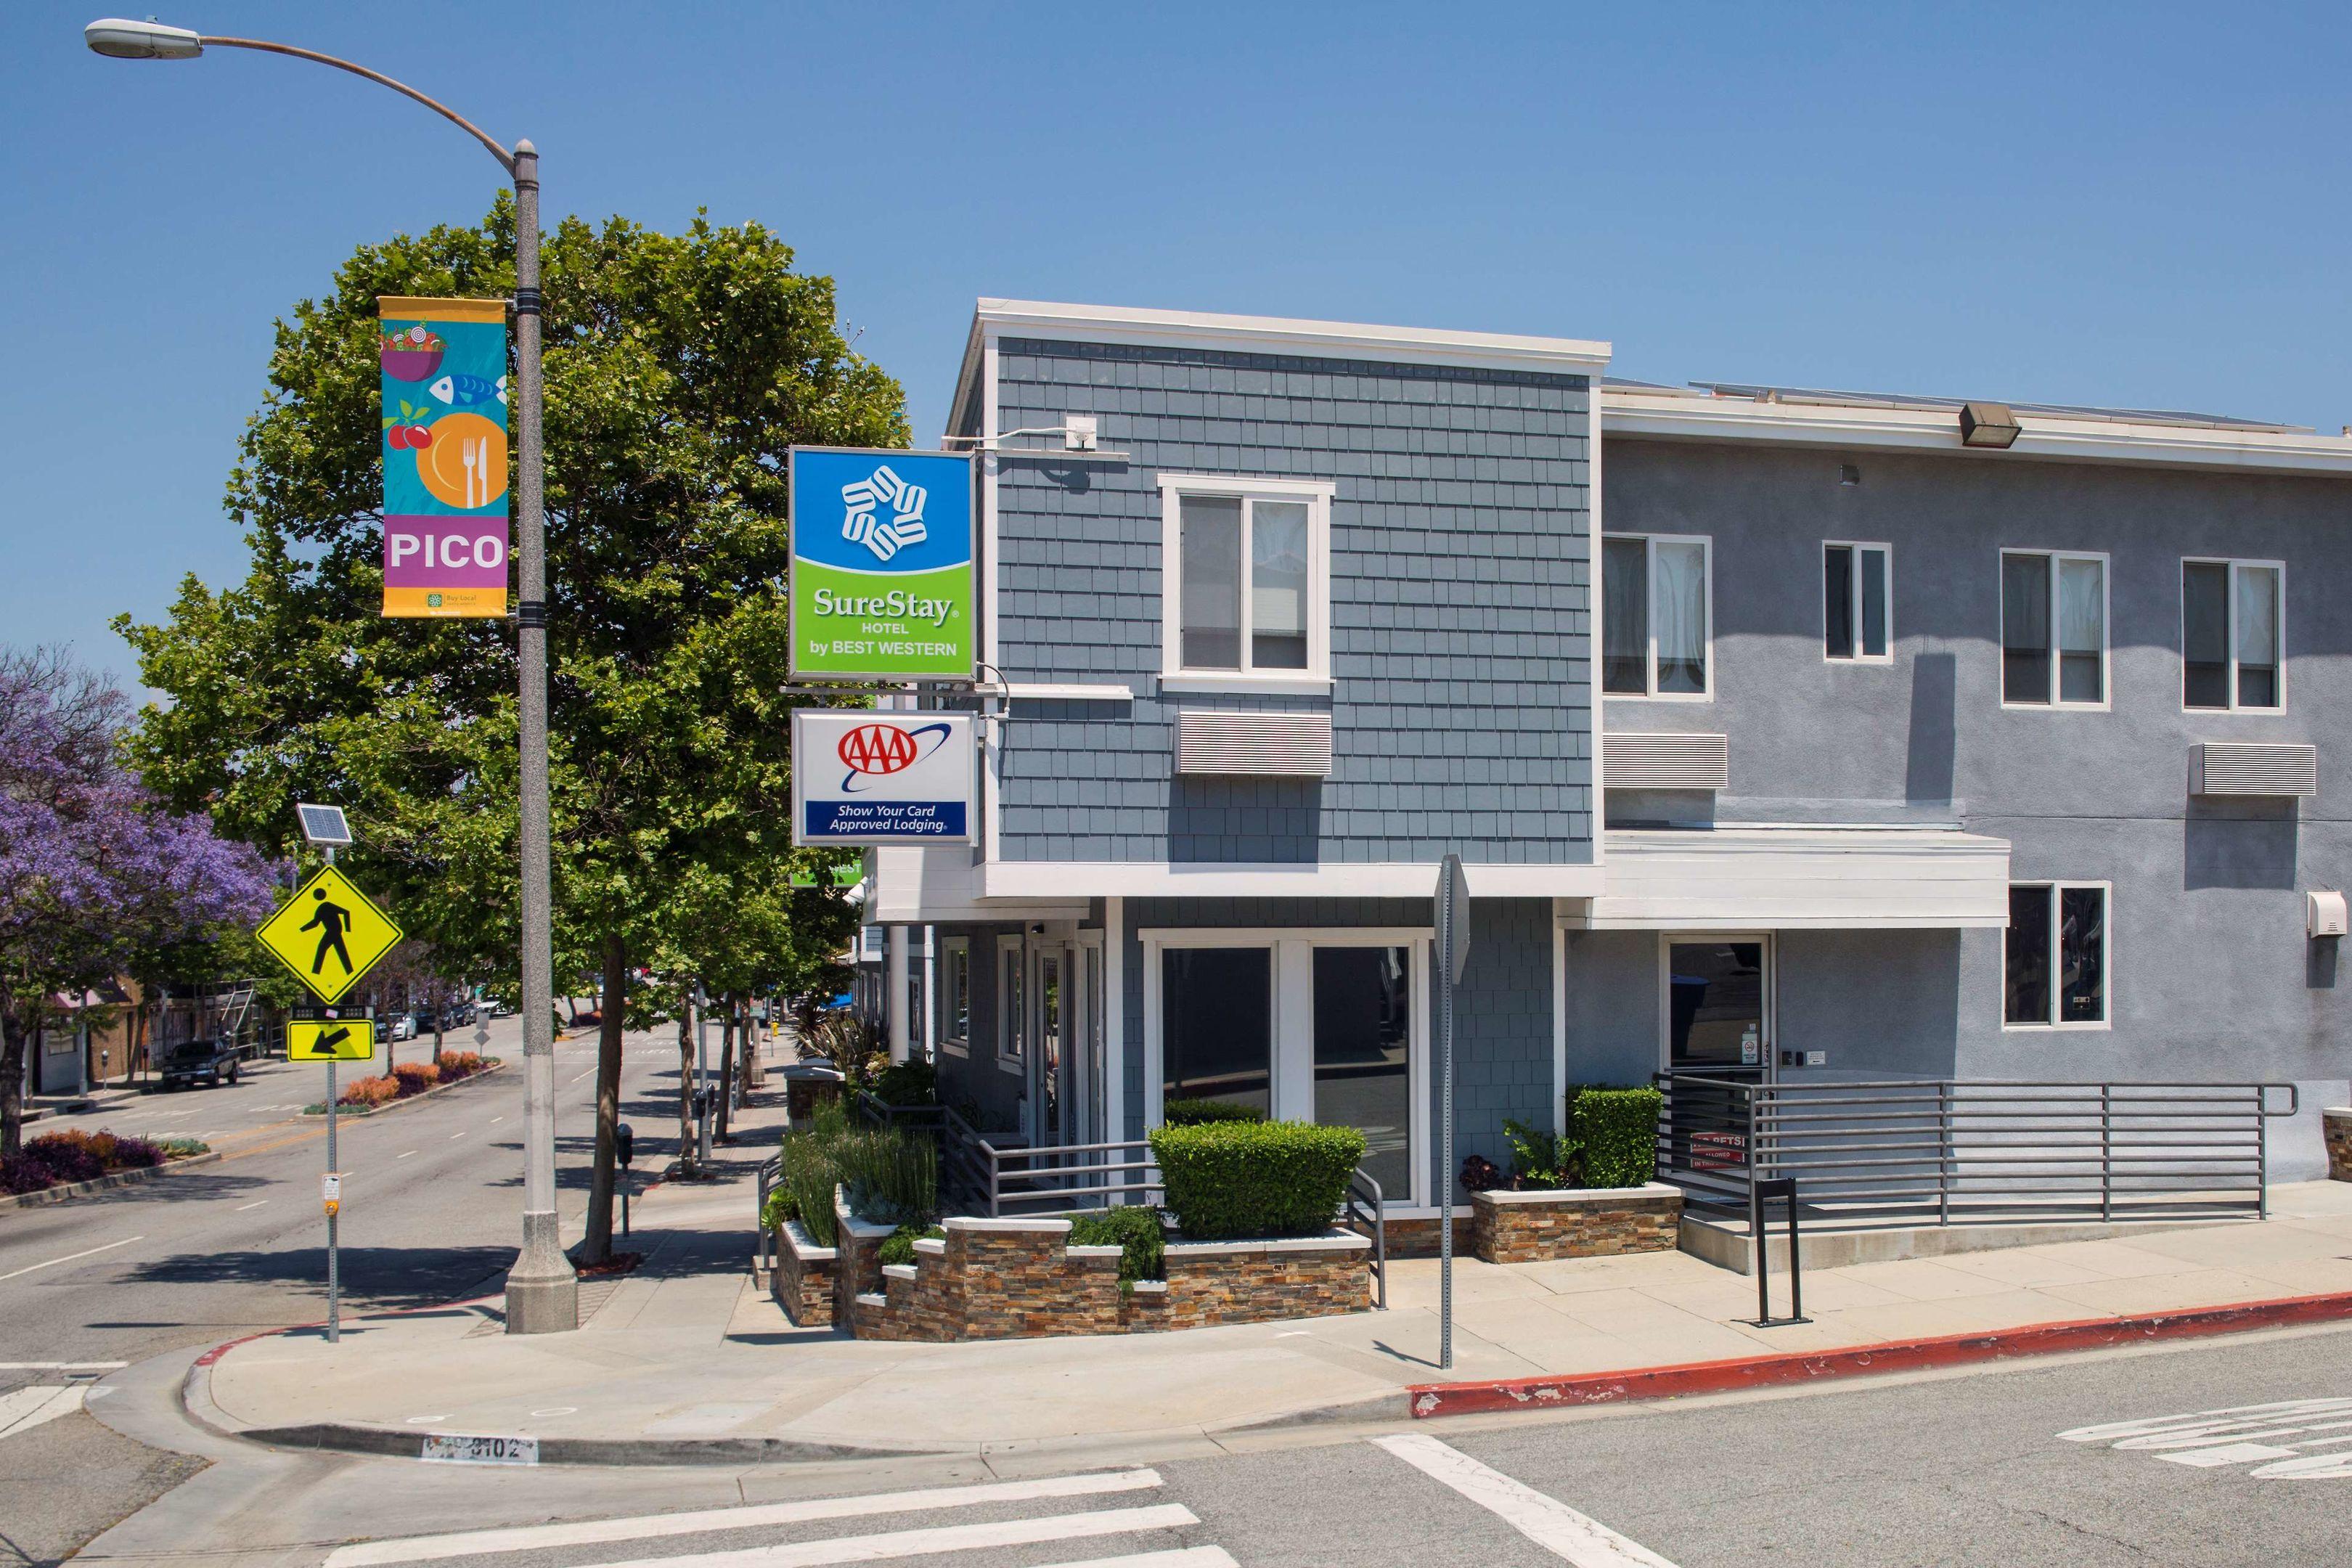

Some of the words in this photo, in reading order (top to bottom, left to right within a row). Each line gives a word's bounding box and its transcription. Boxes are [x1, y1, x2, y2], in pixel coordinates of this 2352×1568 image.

[391, 534, 504, 568] PICO
[862, 622, 910, 634] HOTEL
[809, 640, 829, 656] by
[833, 641, 875, 654] BEST
[878, 642, 957, 656] WESTERN
[846, 725, 909, 773] AAA
[838, 805, 873, 817] Show
[876, 806, 905, 817] Your
[907, 805, 936, 817] Card
[829, 819, 892, 833] Approved
